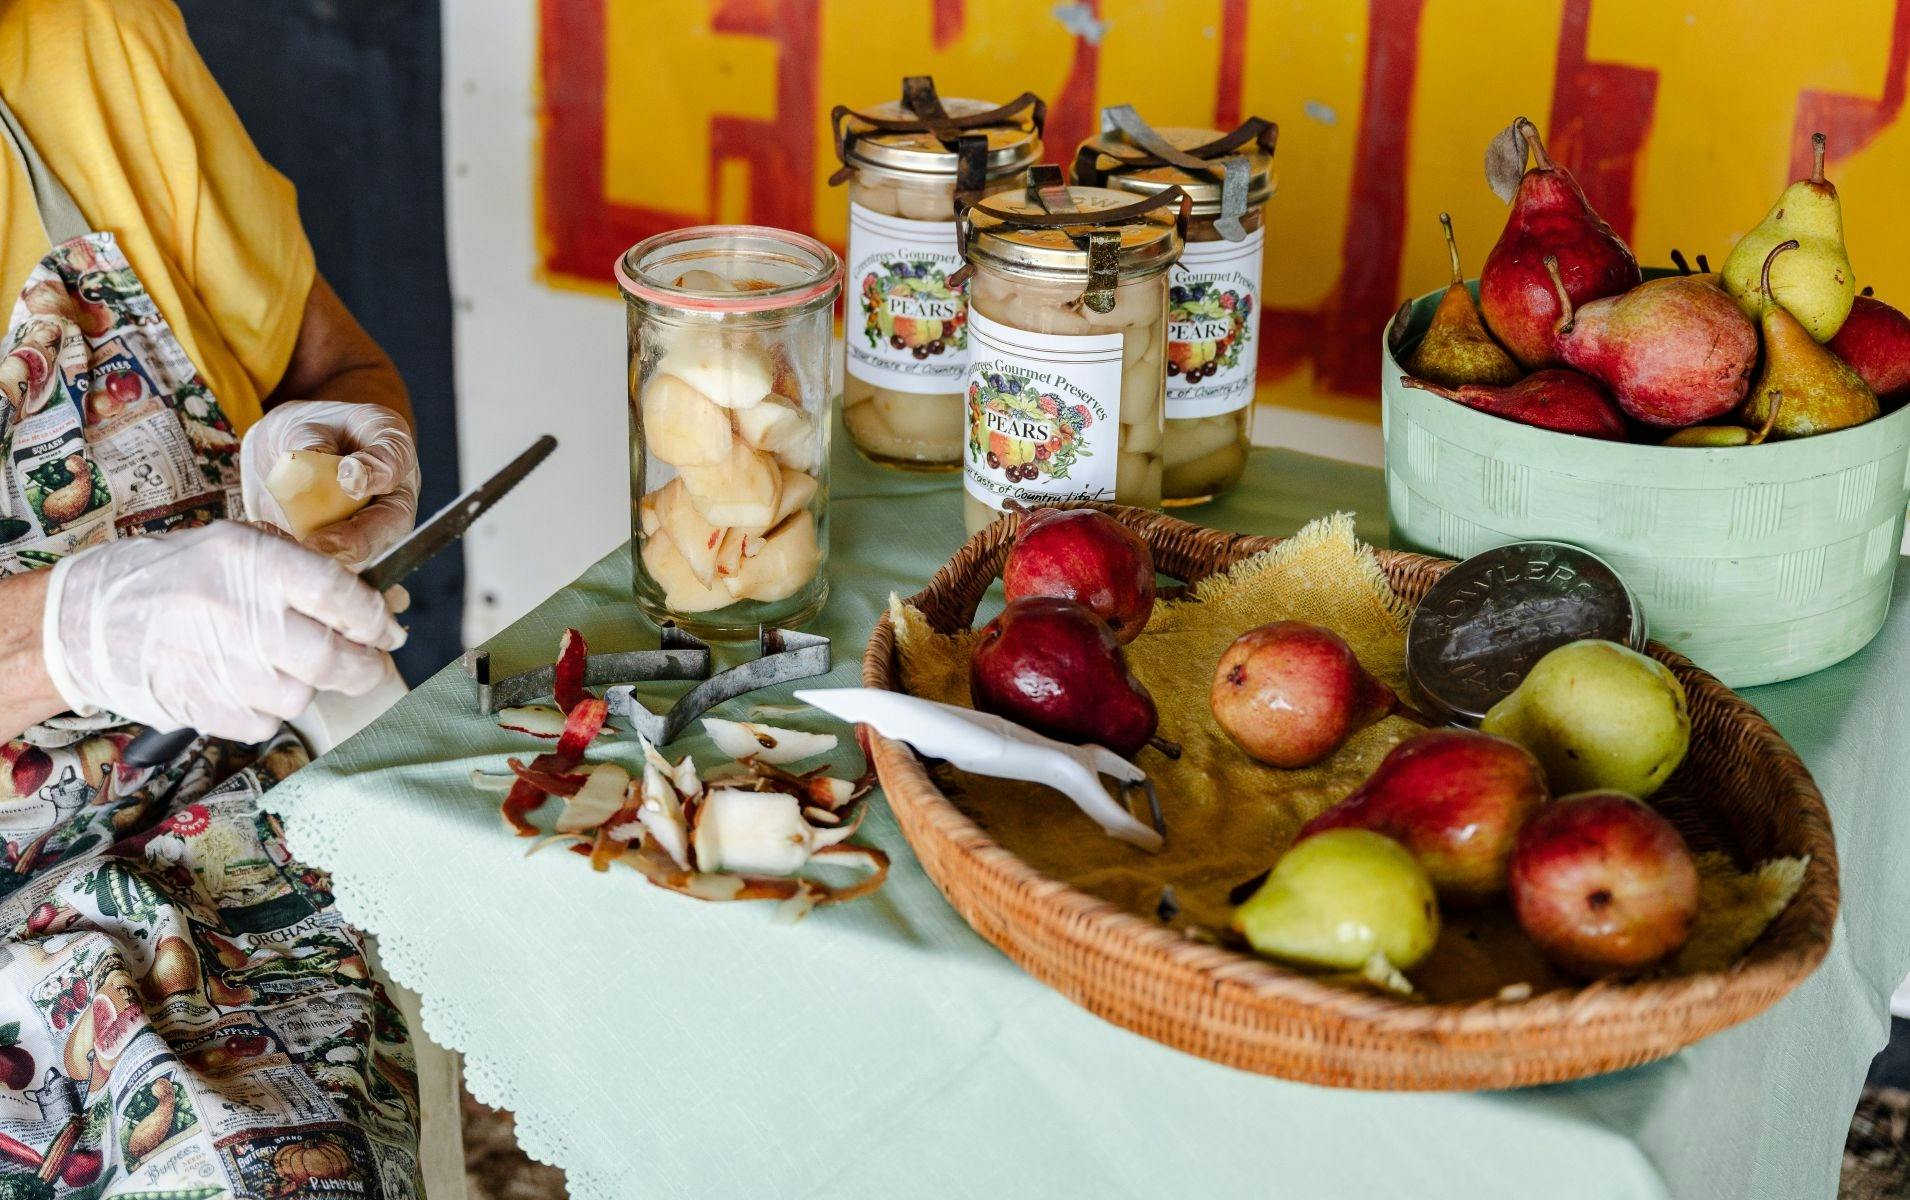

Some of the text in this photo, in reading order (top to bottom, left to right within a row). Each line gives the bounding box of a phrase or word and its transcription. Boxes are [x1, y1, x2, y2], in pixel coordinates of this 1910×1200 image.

[898, 247, 957, 265] Gourmet
[1175, 271, 1231, 284] Gourmet
[890, 299, 954, 317] PEARS
[93, 360, 131, 379] APPLES
[904, 362, 920, 373] of
[994, 358, 1051, 385] Gourmet
[1054, 374, 1108, 422] Preserves
[987, 412, 1048, 442] PEARS
[31, 437, 65, 455] SQUASH
[973, 470, 994, 490] taste
[998, 484, 1013, 494] of
[1014, 487, 1062, 503] Country
[172, 817, 206, 831] CENTS
[214, 1028, 260, 1040] APPLES
[274, 1135, 302, 1144] BRAND
[236, 1145, 278, 1169] BUTTERFLY
[309, 1176, 364, 1193] PUMPKIN
